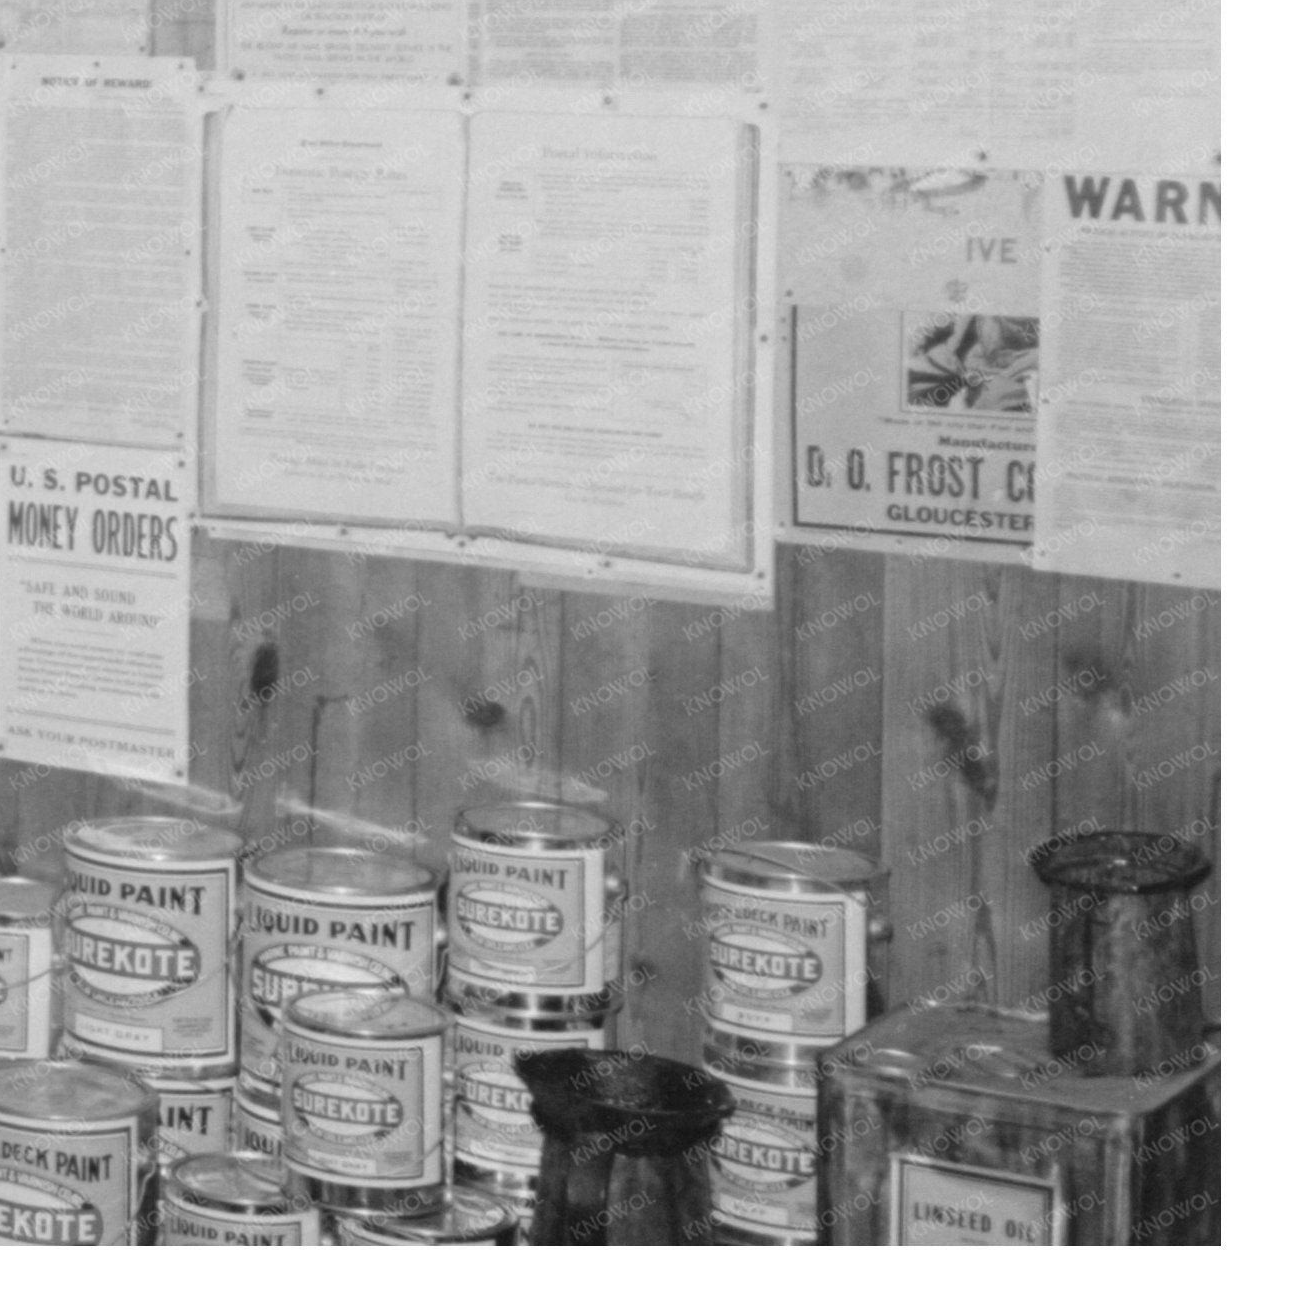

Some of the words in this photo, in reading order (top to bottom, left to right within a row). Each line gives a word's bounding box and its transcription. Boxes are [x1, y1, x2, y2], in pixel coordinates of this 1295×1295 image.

[10, 464, 33, 489] U.
[43, 467, 66, 491] S.
[75, 471, 179, 503] POSTAL
[886, 450, 985, 501] FROST
[8, 500, 79, 551] MONEY
[92, 509, 178, 562] ORDERS
[63, 582, 89, 599] AND
[94, 586, 136, 605] SOUND
[8, 724, 33, 739] ASK
[37, 727, 73, 745] YOUR
[77, 733, 176, 759] POSTMASTER
[453, 852, 500, 876] LIQUID
[505, 862, 569, 890] PAINT
[119, 882, 207, 916] PAINT
[456, 901, 561, 934] SUREKOTE
[250, 906, 317, 939] LIQUID
[330, 919, 415, 950] PAINT
[783, 913, 830, 939] PAINT
[710, 942, 820, 979] SUREKOTE
[287, 1042, 340, 1069] LIQUID
[344, 1054, 409, 1082] PAINT
[293, 1088, 402, 1124] SUREKOTE
[1, 1142, 49, 1171] DECK
[55, 1149, 114, 1183] PAINT
[914, 1202, 992, 1233] LINSEED
